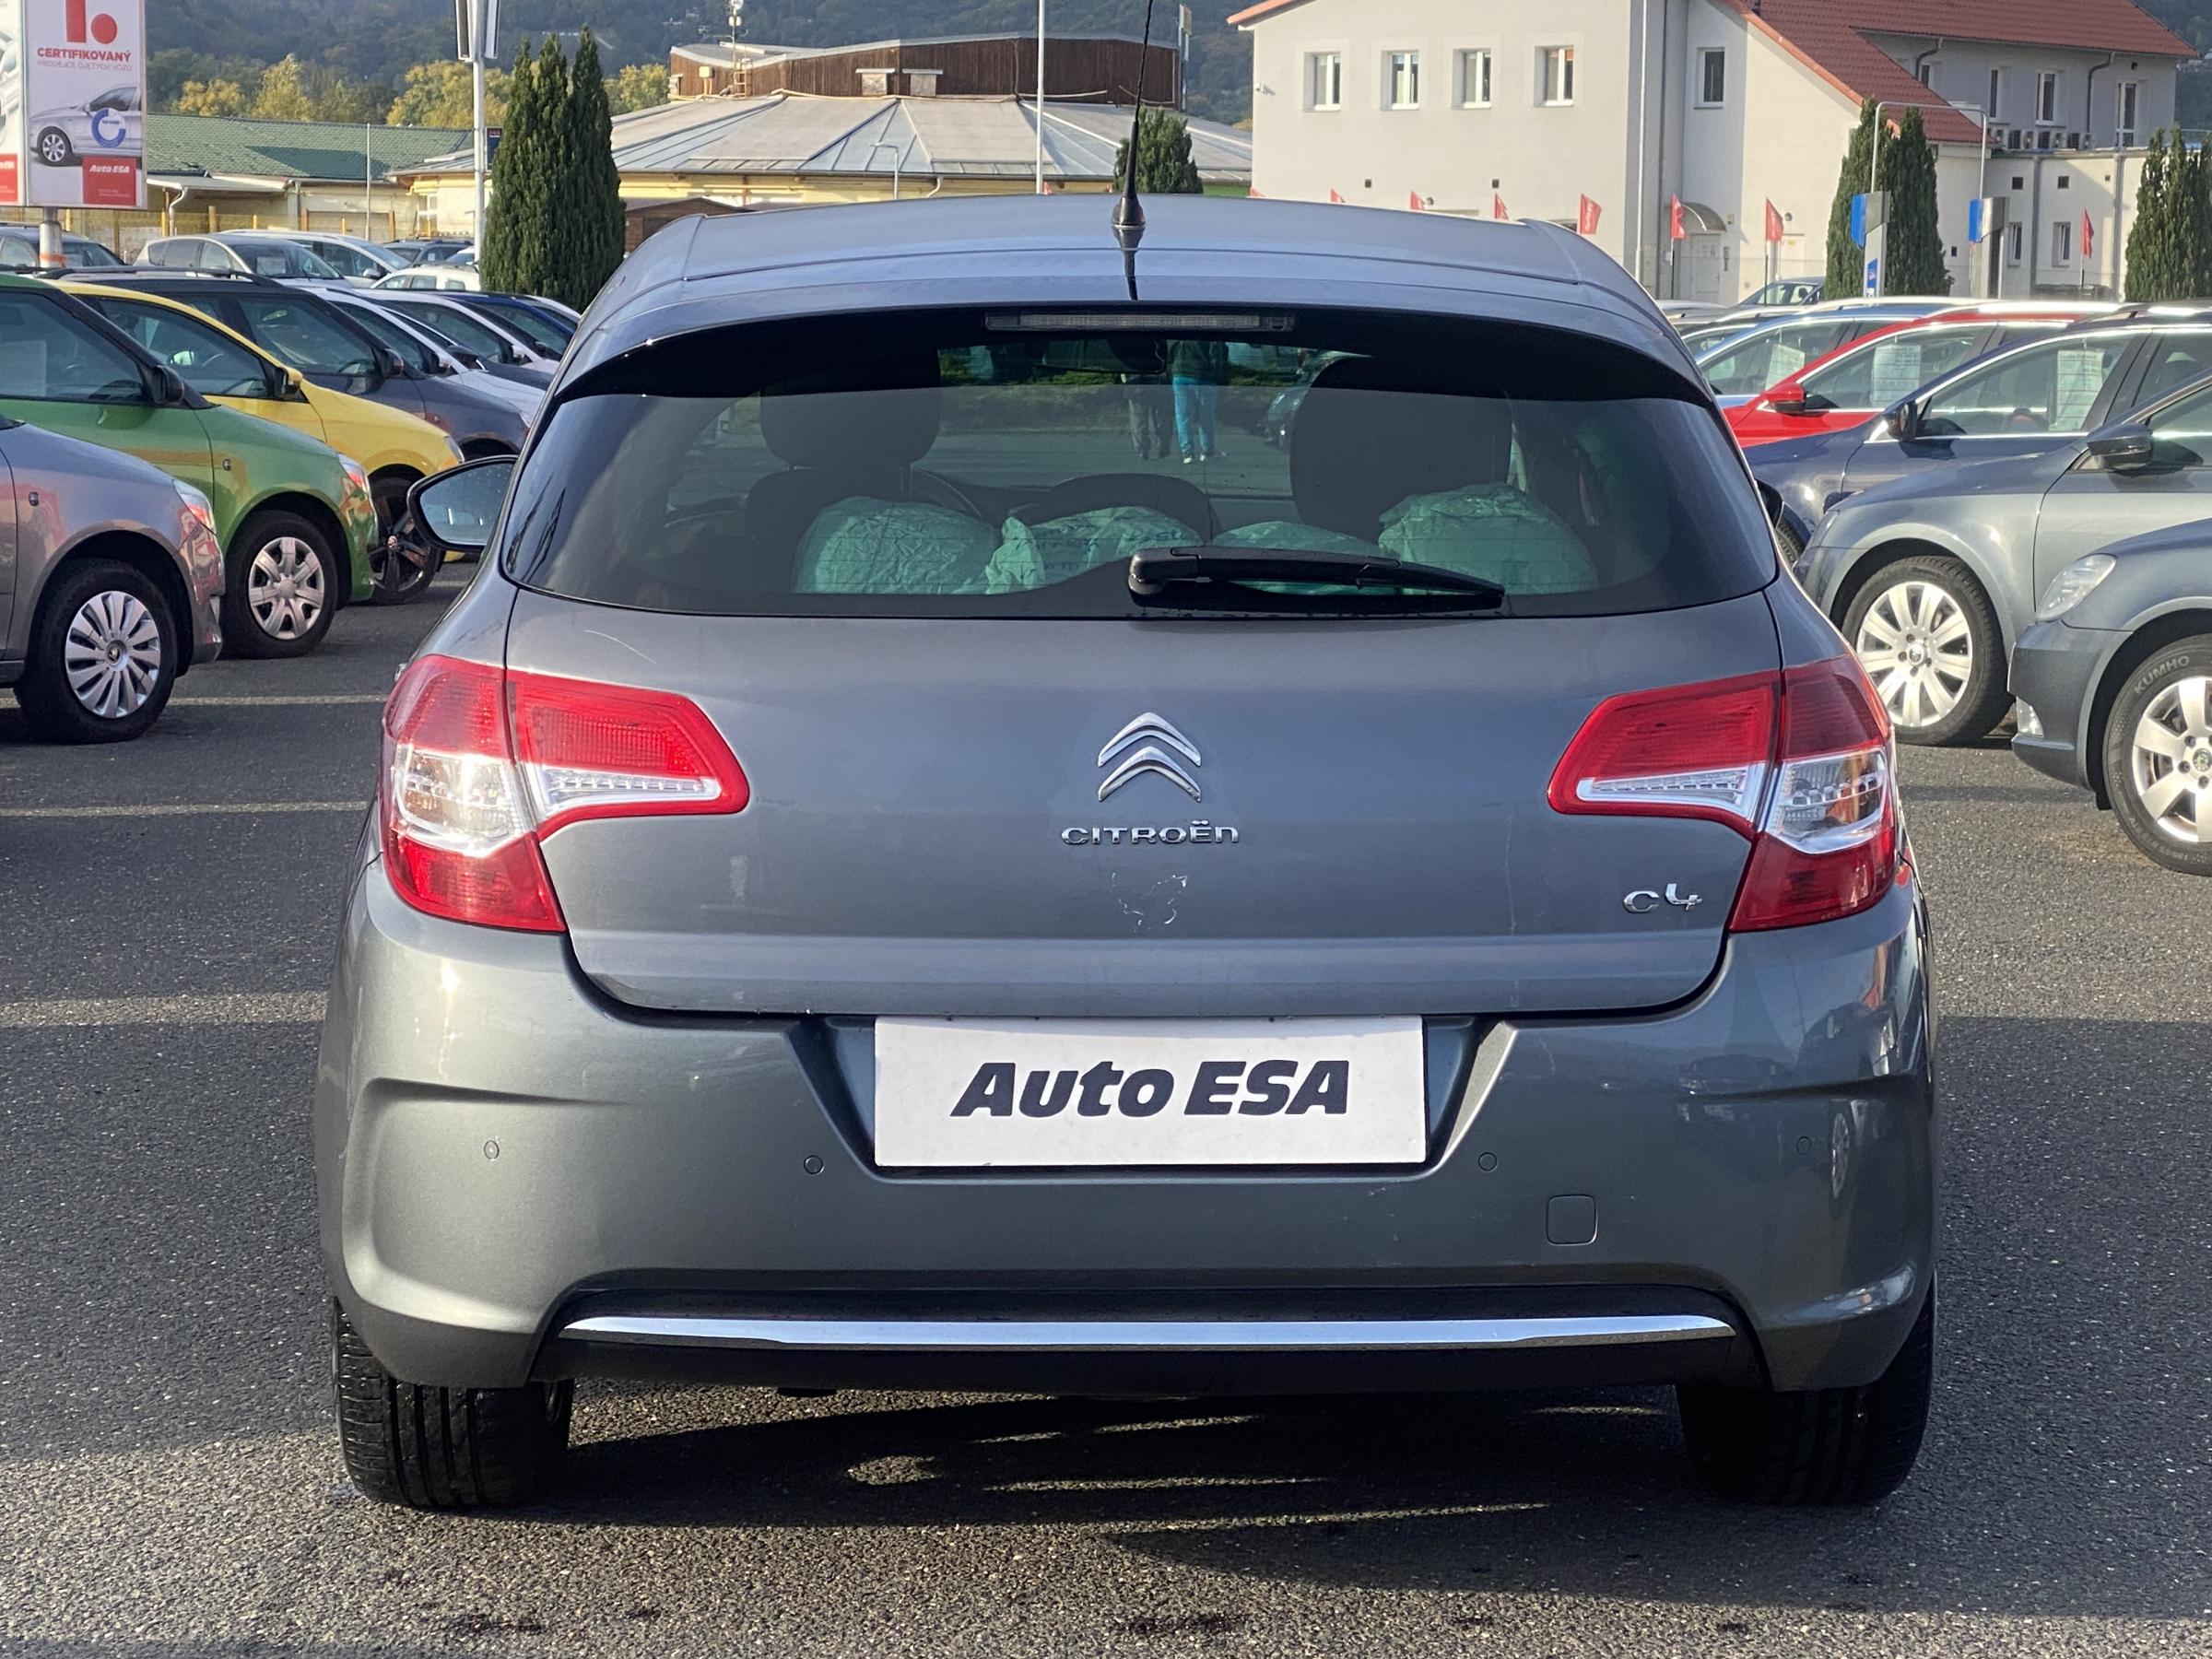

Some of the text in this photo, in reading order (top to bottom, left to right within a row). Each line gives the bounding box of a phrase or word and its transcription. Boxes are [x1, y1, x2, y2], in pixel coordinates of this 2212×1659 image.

[37, 47, 131, 62] CERTIFIKOVANÝ
[89, 164, 130, 173] Auto ESA
[2135, 655, 2190, 694] KUMHO
[949, 1059, 1350, 1117] Auto ESA
